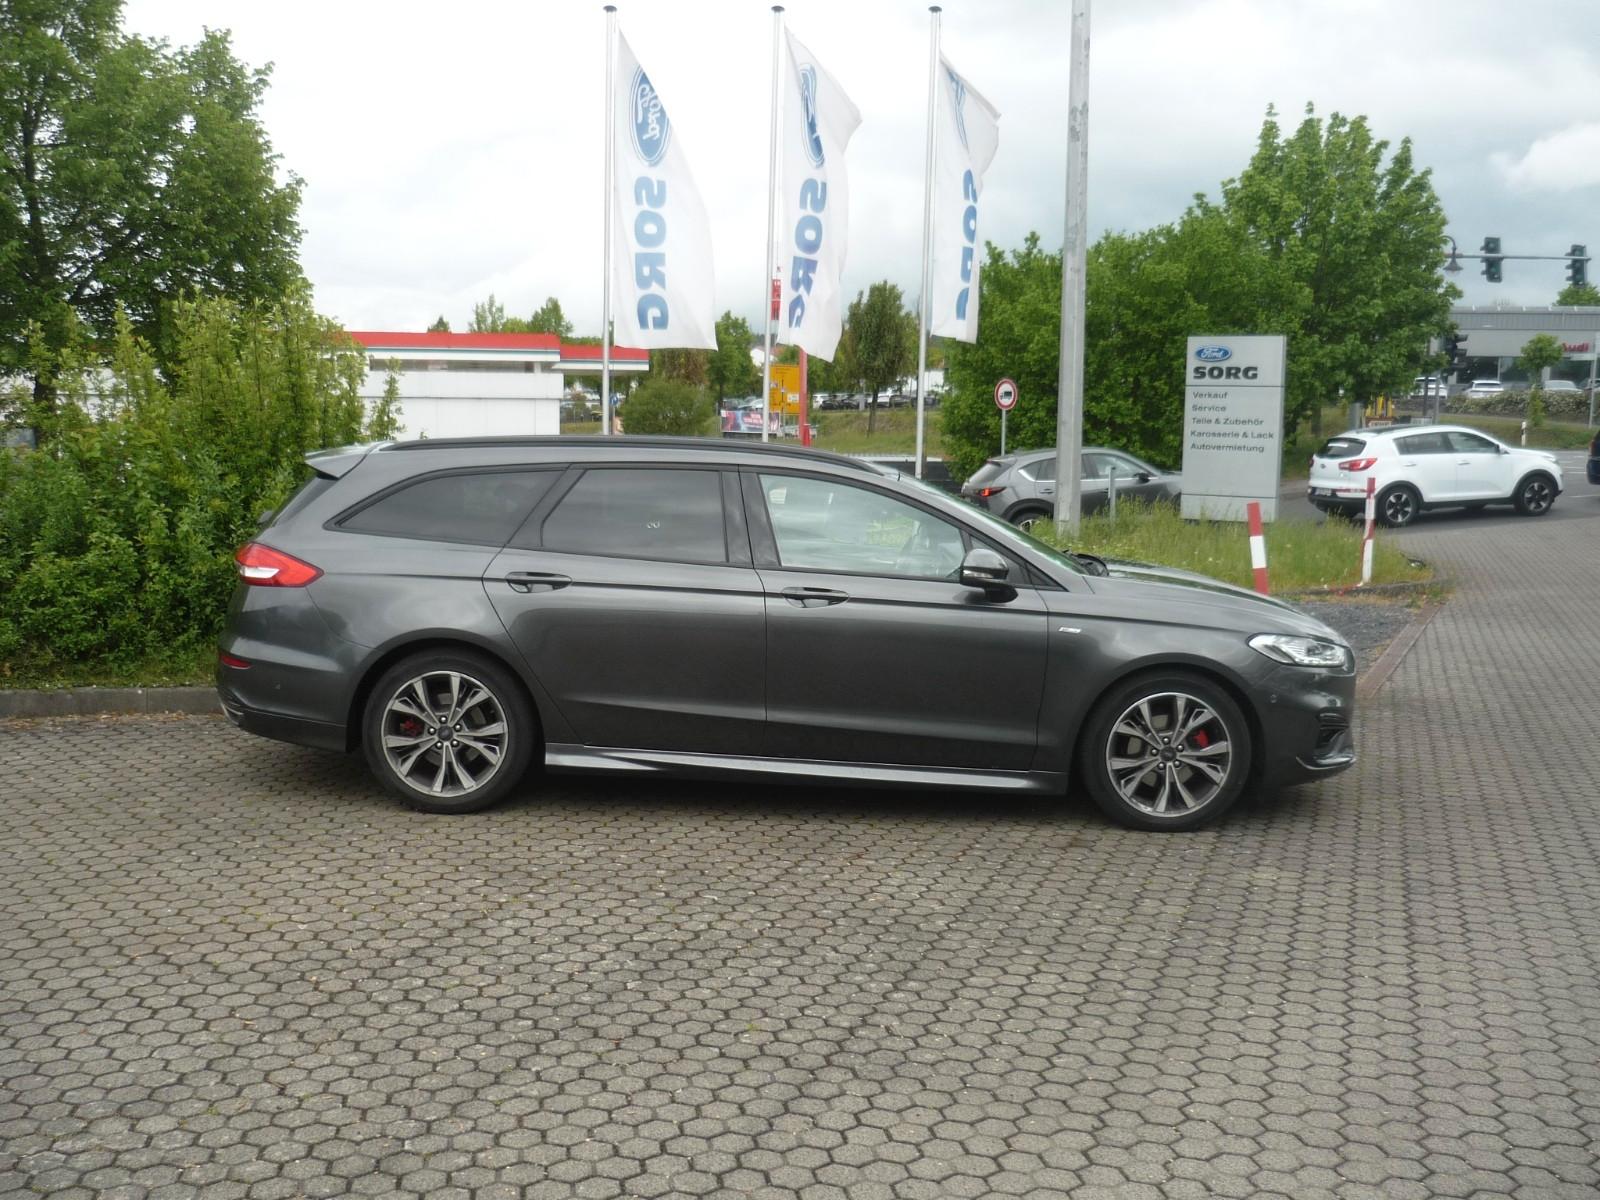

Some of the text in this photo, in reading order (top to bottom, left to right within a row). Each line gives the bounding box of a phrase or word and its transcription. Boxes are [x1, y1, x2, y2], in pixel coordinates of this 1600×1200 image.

[1193, 366, 1258, 379] SORG
[1192, 391, 1228, 399] Verkauf
[1191, 404, 1227, 412] Service
[1192, 417, 1213, 425] Teile
[1223, 417, 1264, 426] Zubehör
[1190, 430, 1275, 440] Karosserie & Lack
[1190, 443, 1265, 453] Autovermietung
